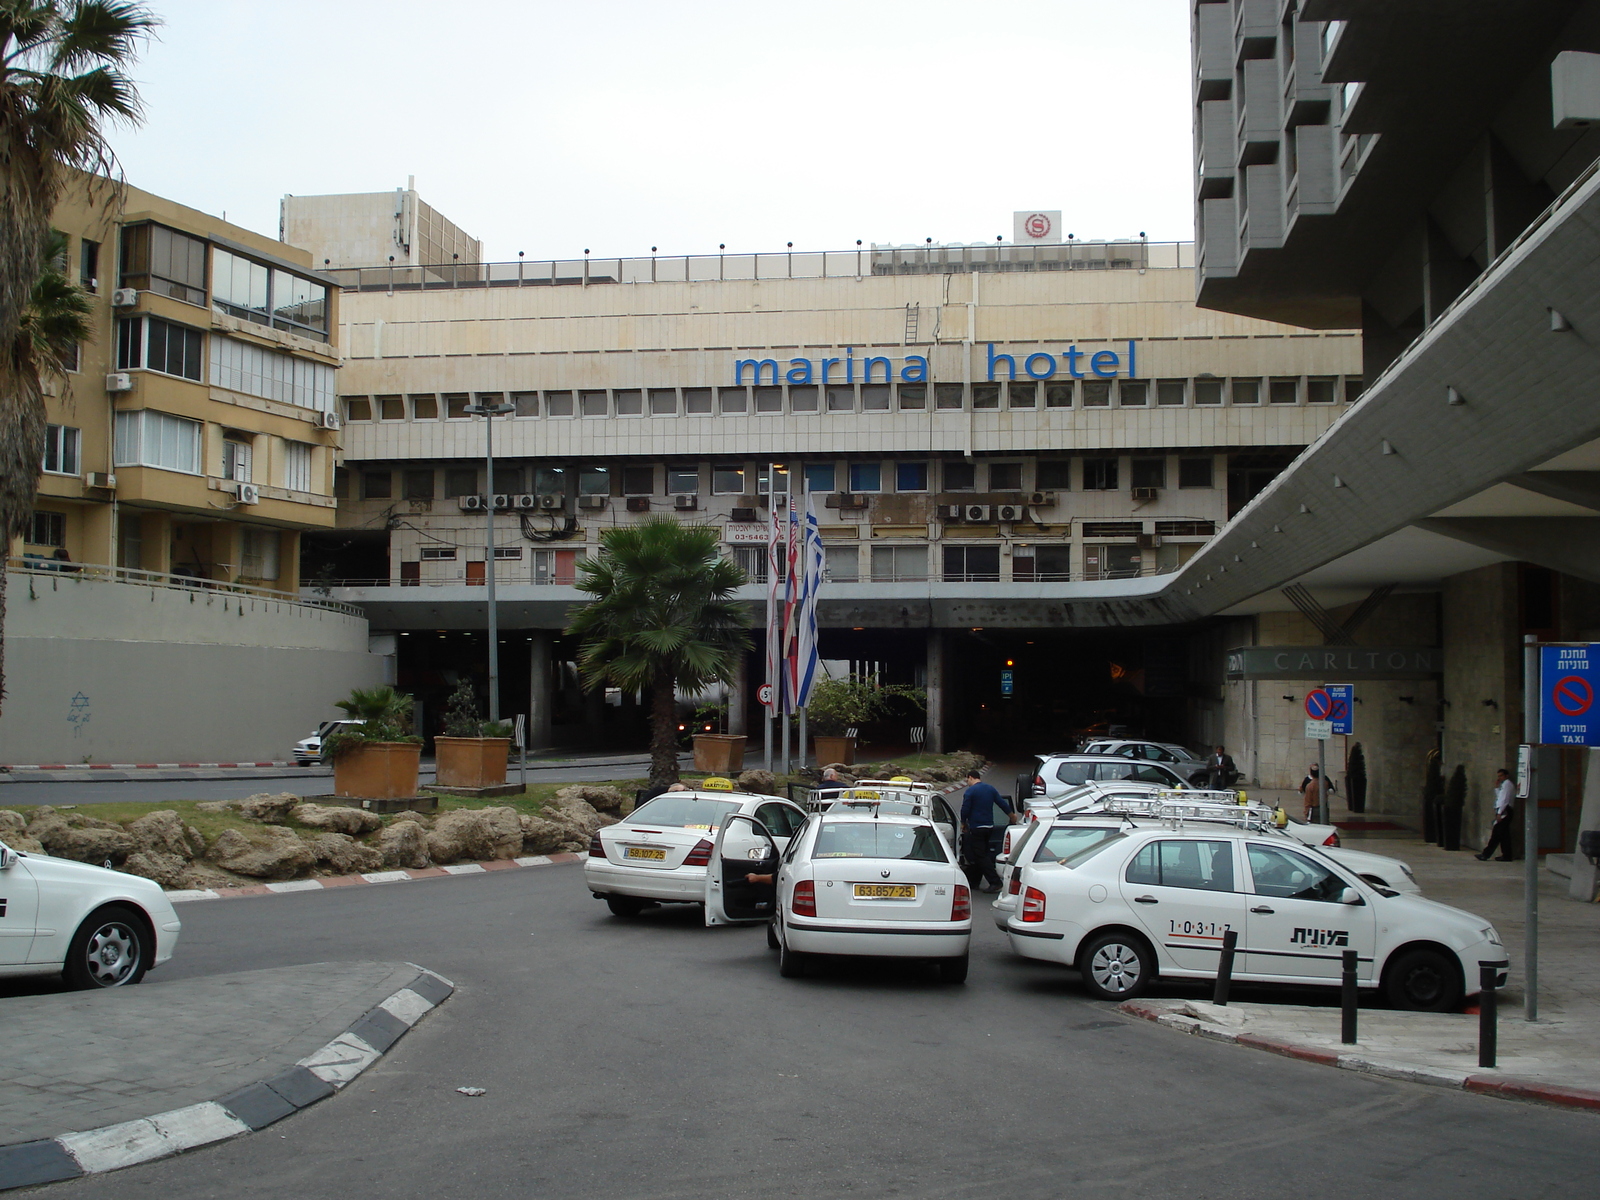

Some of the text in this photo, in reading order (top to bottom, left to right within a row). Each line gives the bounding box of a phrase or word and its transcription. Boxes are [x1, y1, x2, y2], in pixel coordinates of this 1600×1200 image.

[735, 340, 1136, 385] marina hotel
[1560, 649, 1587, 659] תחנת
[1274, 652, 1432, 669] CARLTON
[1557, 660, 1590, 670] מוניות
[1559, 724, 1587, 733] מוניות
[1562, 735, 1585, 744] TAXI
